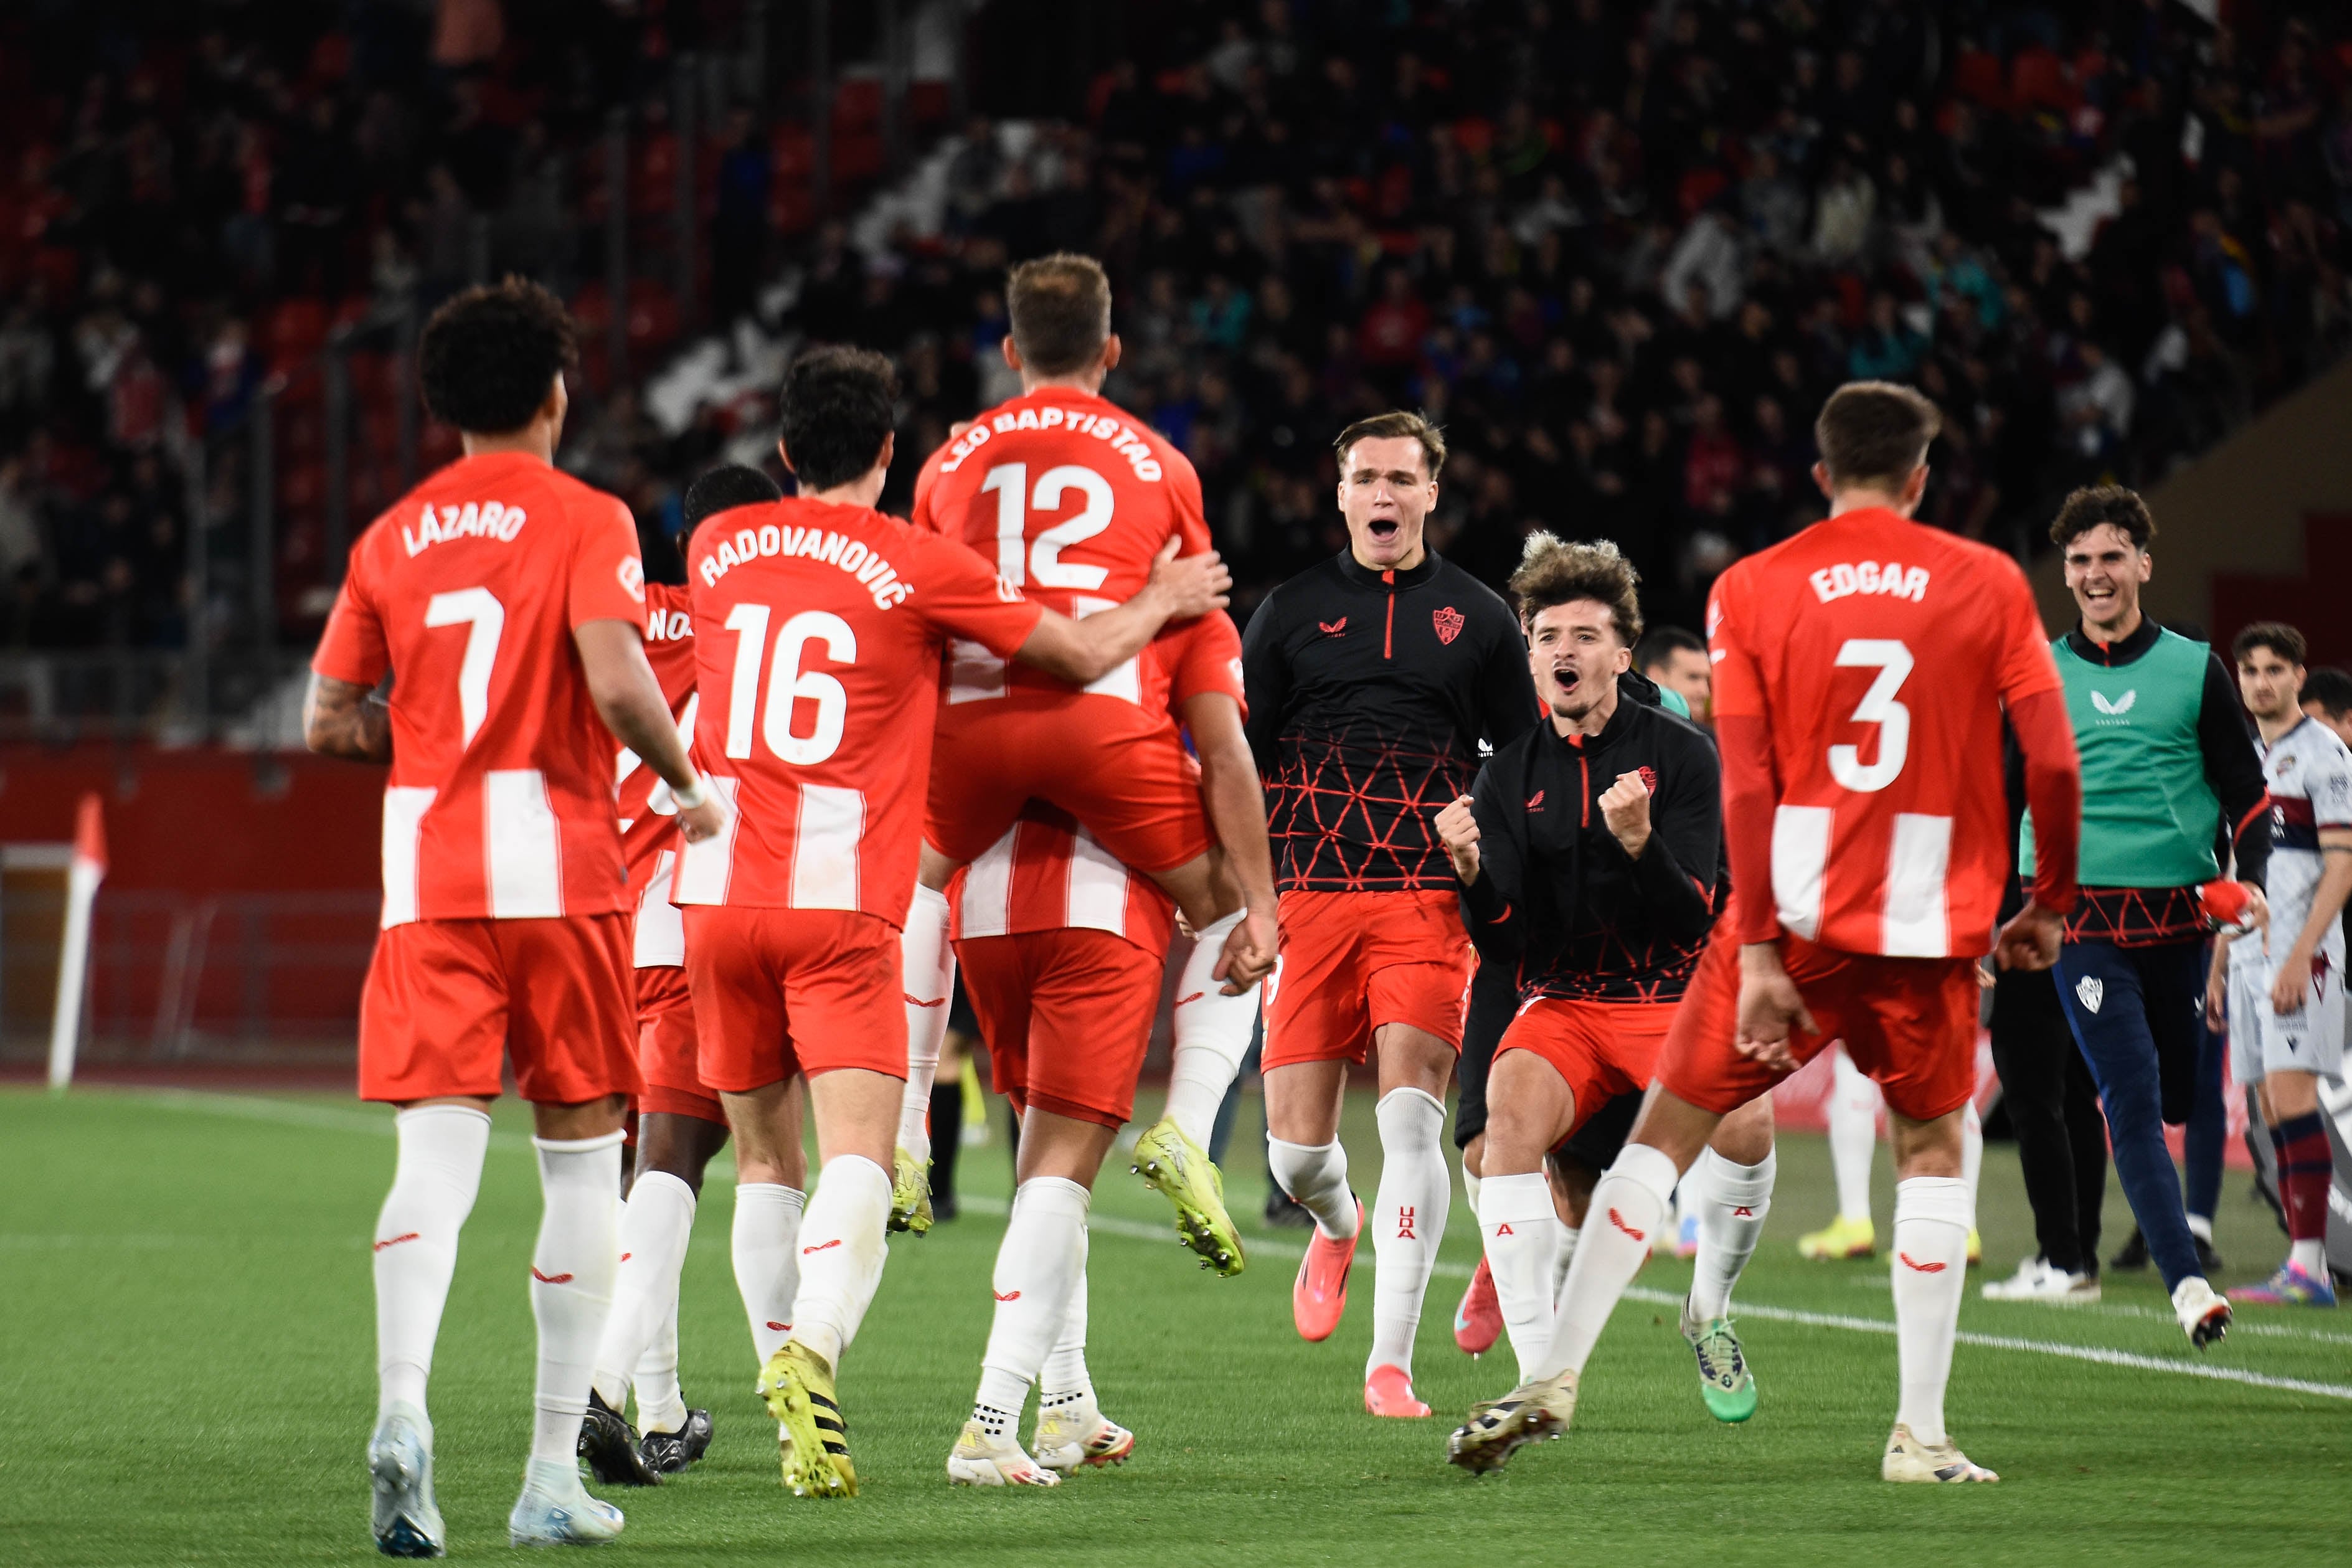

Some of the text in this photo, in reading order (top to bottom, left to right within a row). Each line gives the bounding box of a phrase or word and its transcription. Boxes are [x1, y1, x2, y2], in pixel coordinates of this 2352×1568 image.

[940, 407, 1162, 482] LEO BAPTISTAO
[402, 501, 526, 558] LÁZARO
[699, 524, 915, 610] RADOVANOVIĆ
[981, 463, 1115, 590] 12
[646, 608, 696, 641] NO
[1810, 560, 1930, 603] EDGAR
[425, 587, 504, 750] 7
[724, 603, 857, 765] 16
[1829, 639, 1914, 792] 3
